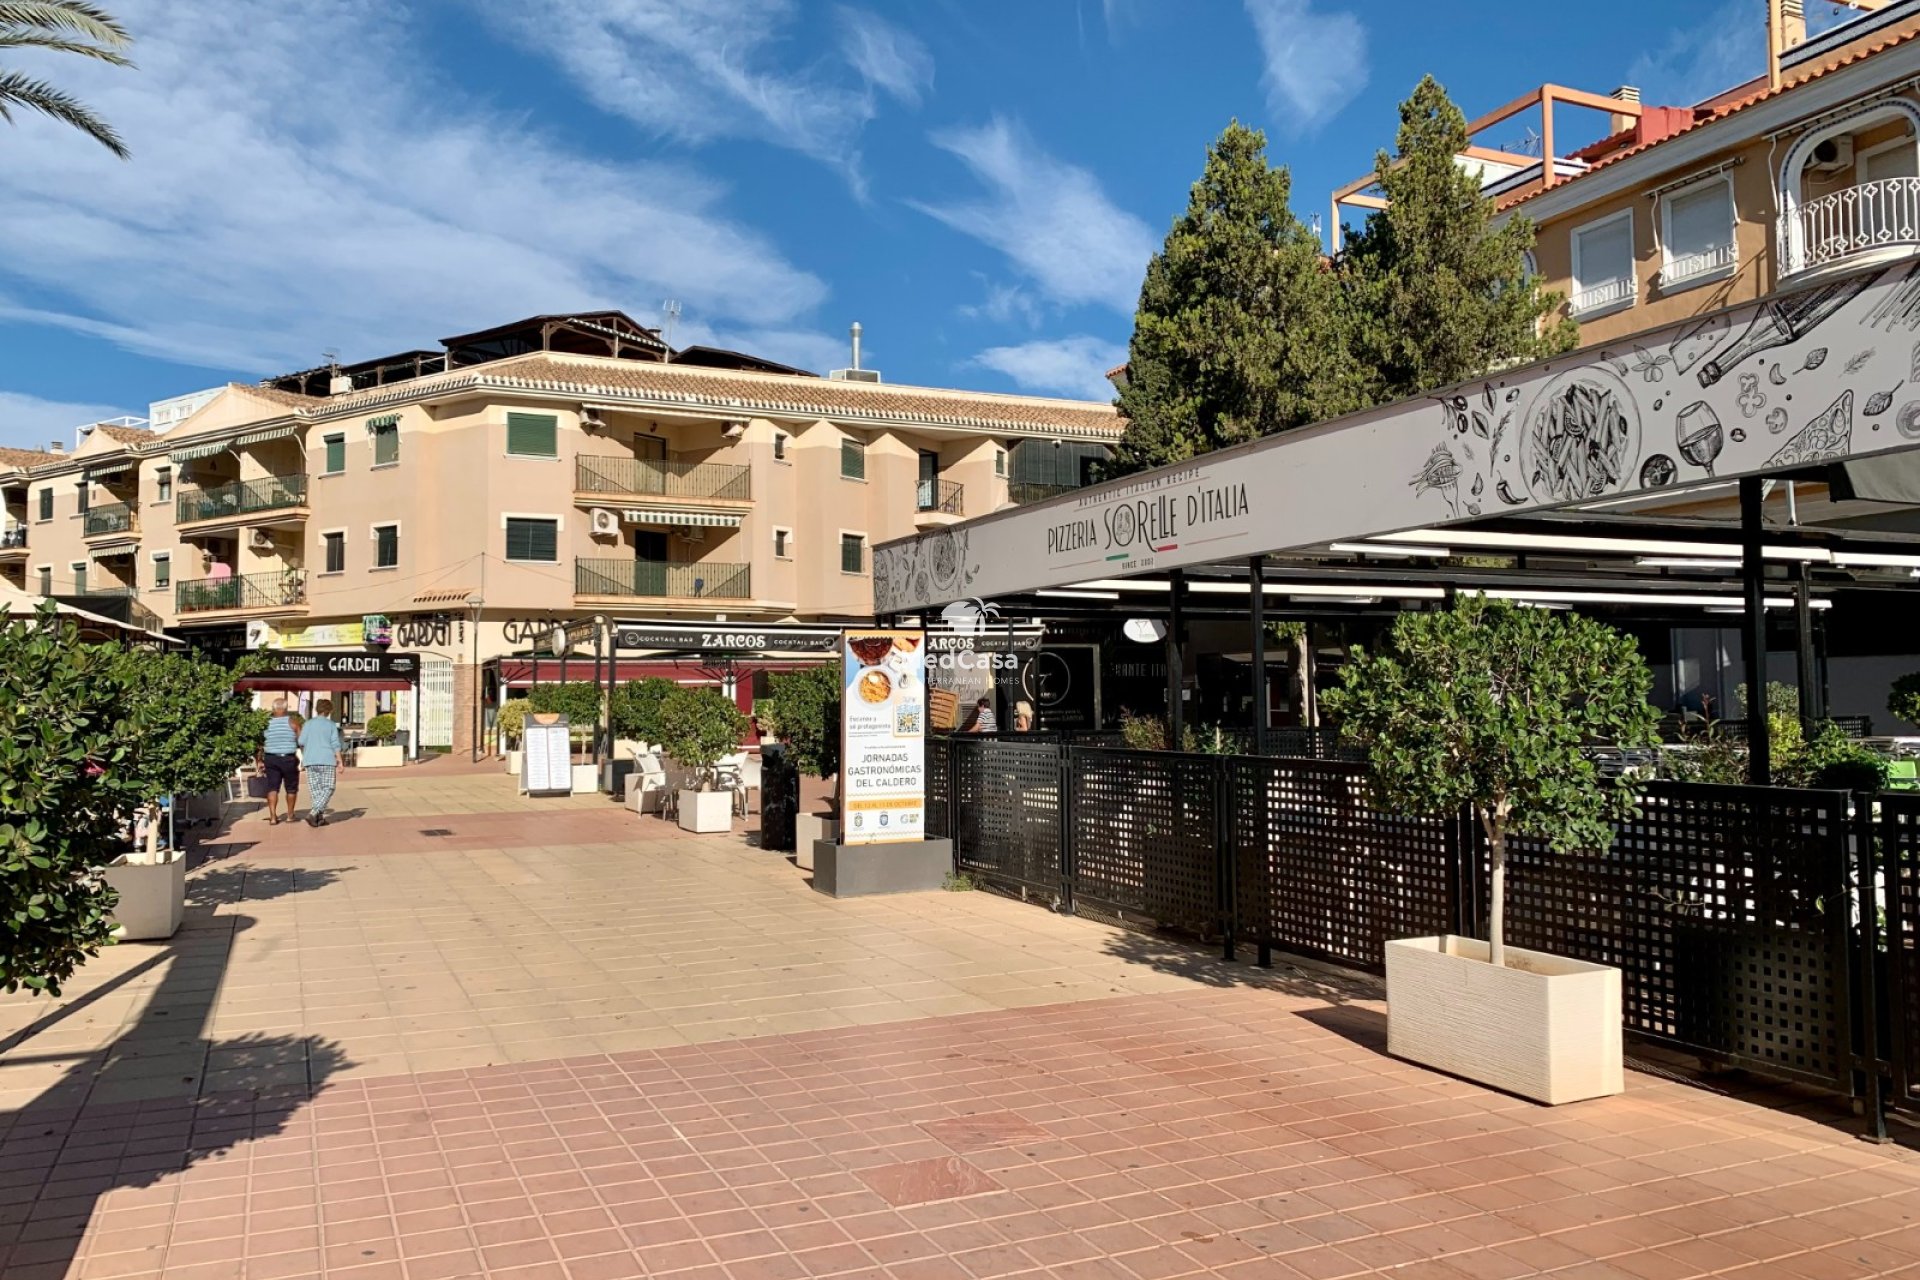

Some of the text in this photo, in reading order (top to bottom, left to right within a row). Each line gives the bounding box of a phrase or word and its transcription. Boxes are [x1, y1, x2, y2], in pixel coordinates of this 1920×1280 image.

[1126, 478, 1160, 495] ITALIAN
[1048, 518, 1098, 555] PIZZERIA
[1187, 482, 1249, 527] D'ITALIA
[1121, 559, 1137, 570] SINCE
[397, 618, 452, 647] GARDEN
[640, 635, 677, 643] COCKTAIL
[702, 634, 766, 648] ZARCOS
[927, 637, 975, 650] ARCOS
[284, 655, 317, 664] PIZZERIA
[328, 657, 380, 672] GARDEN
[861, 753, 909, 763] JORNADAS
[848, 764, 922, 776] GASTRONÓMICAS
[856, 777, 917, 788] DEL CALDERO
